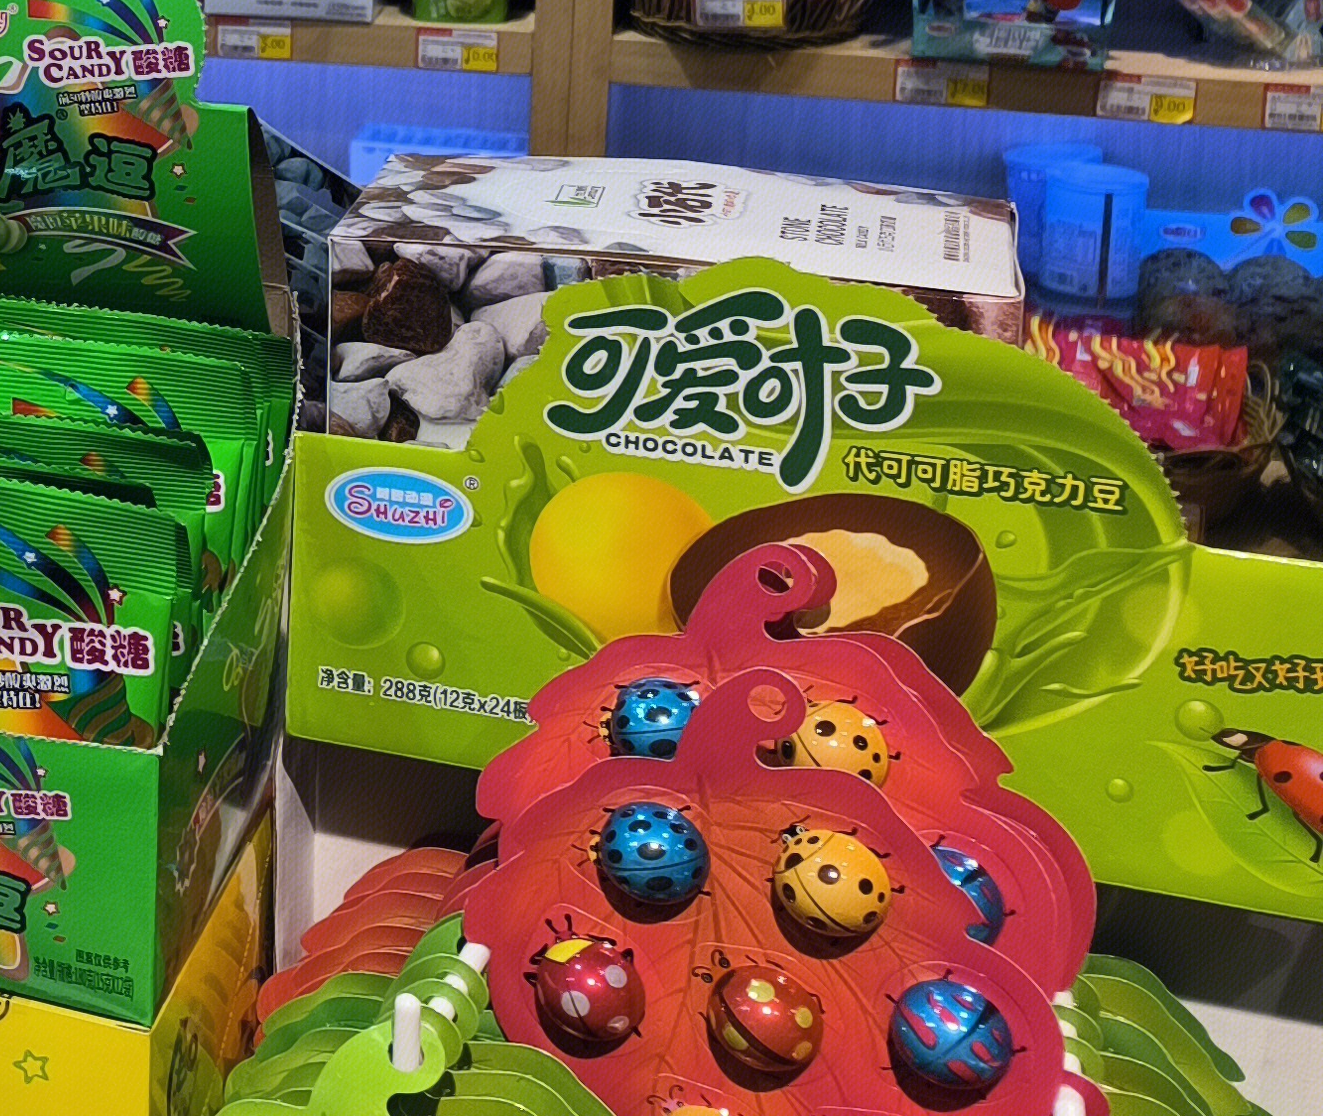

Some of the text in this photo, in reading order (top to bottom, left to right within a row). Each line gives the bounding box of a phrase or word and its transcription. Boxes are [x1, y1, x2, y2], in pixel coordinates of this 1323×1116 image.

[27, 39, 103, 61] SOUR
[44, 46, 190, 82] CANDY 酸糖
[546, 290, 935, 488] 可爱叶子
[605, 432, 775, 468] CHOCOLATE
[844, 447, 1125, 512] 代可可脂巧克力豆
[69, 627, 150, 670] 酸糖
[12, 793, 69, 818] 酸糖
